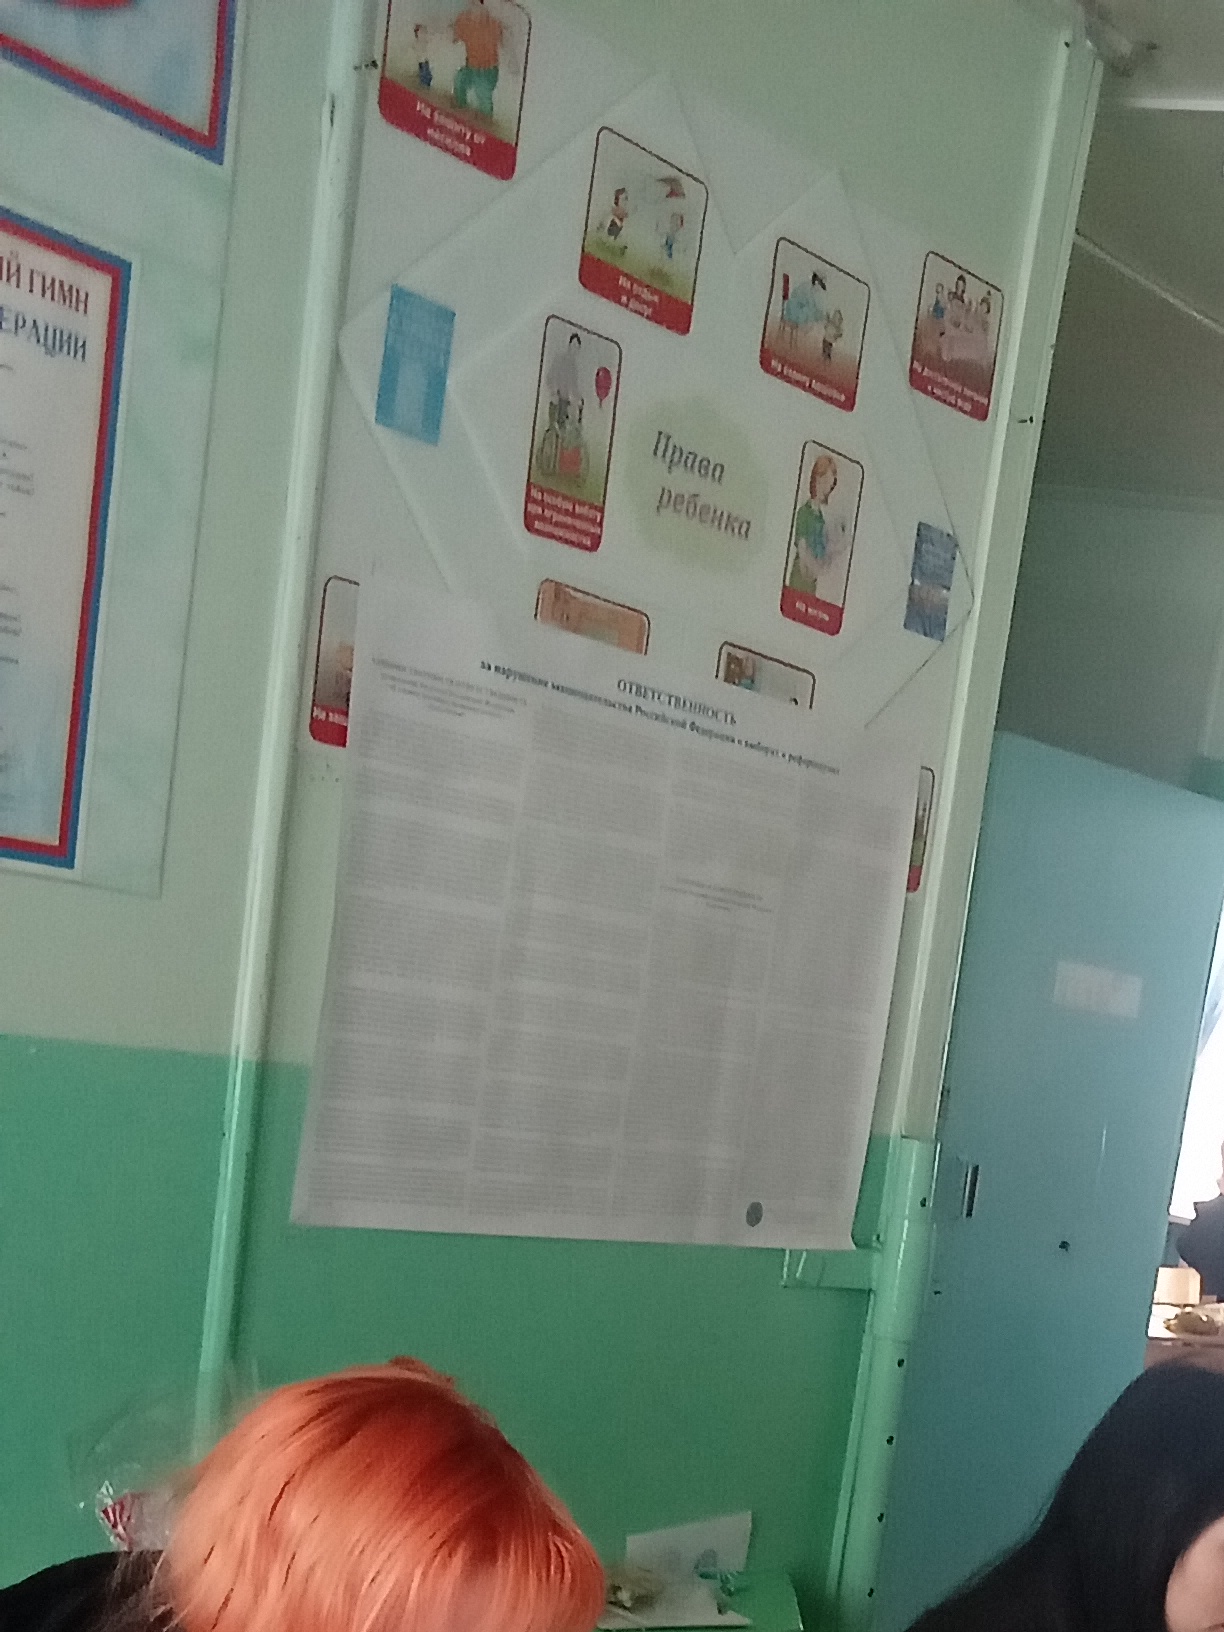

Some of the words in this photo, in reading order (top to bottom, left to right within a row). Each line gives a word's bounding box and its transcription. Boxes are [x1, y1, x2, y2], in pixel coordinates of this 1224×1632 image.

[28, 268, 90, 315] ГИМН
[653, 430, 725, 485] Права
[656, 486, 751, 540] ребенка
[617, 679, 737, 726] ОТВЕТСТВЕННОСТЬ
